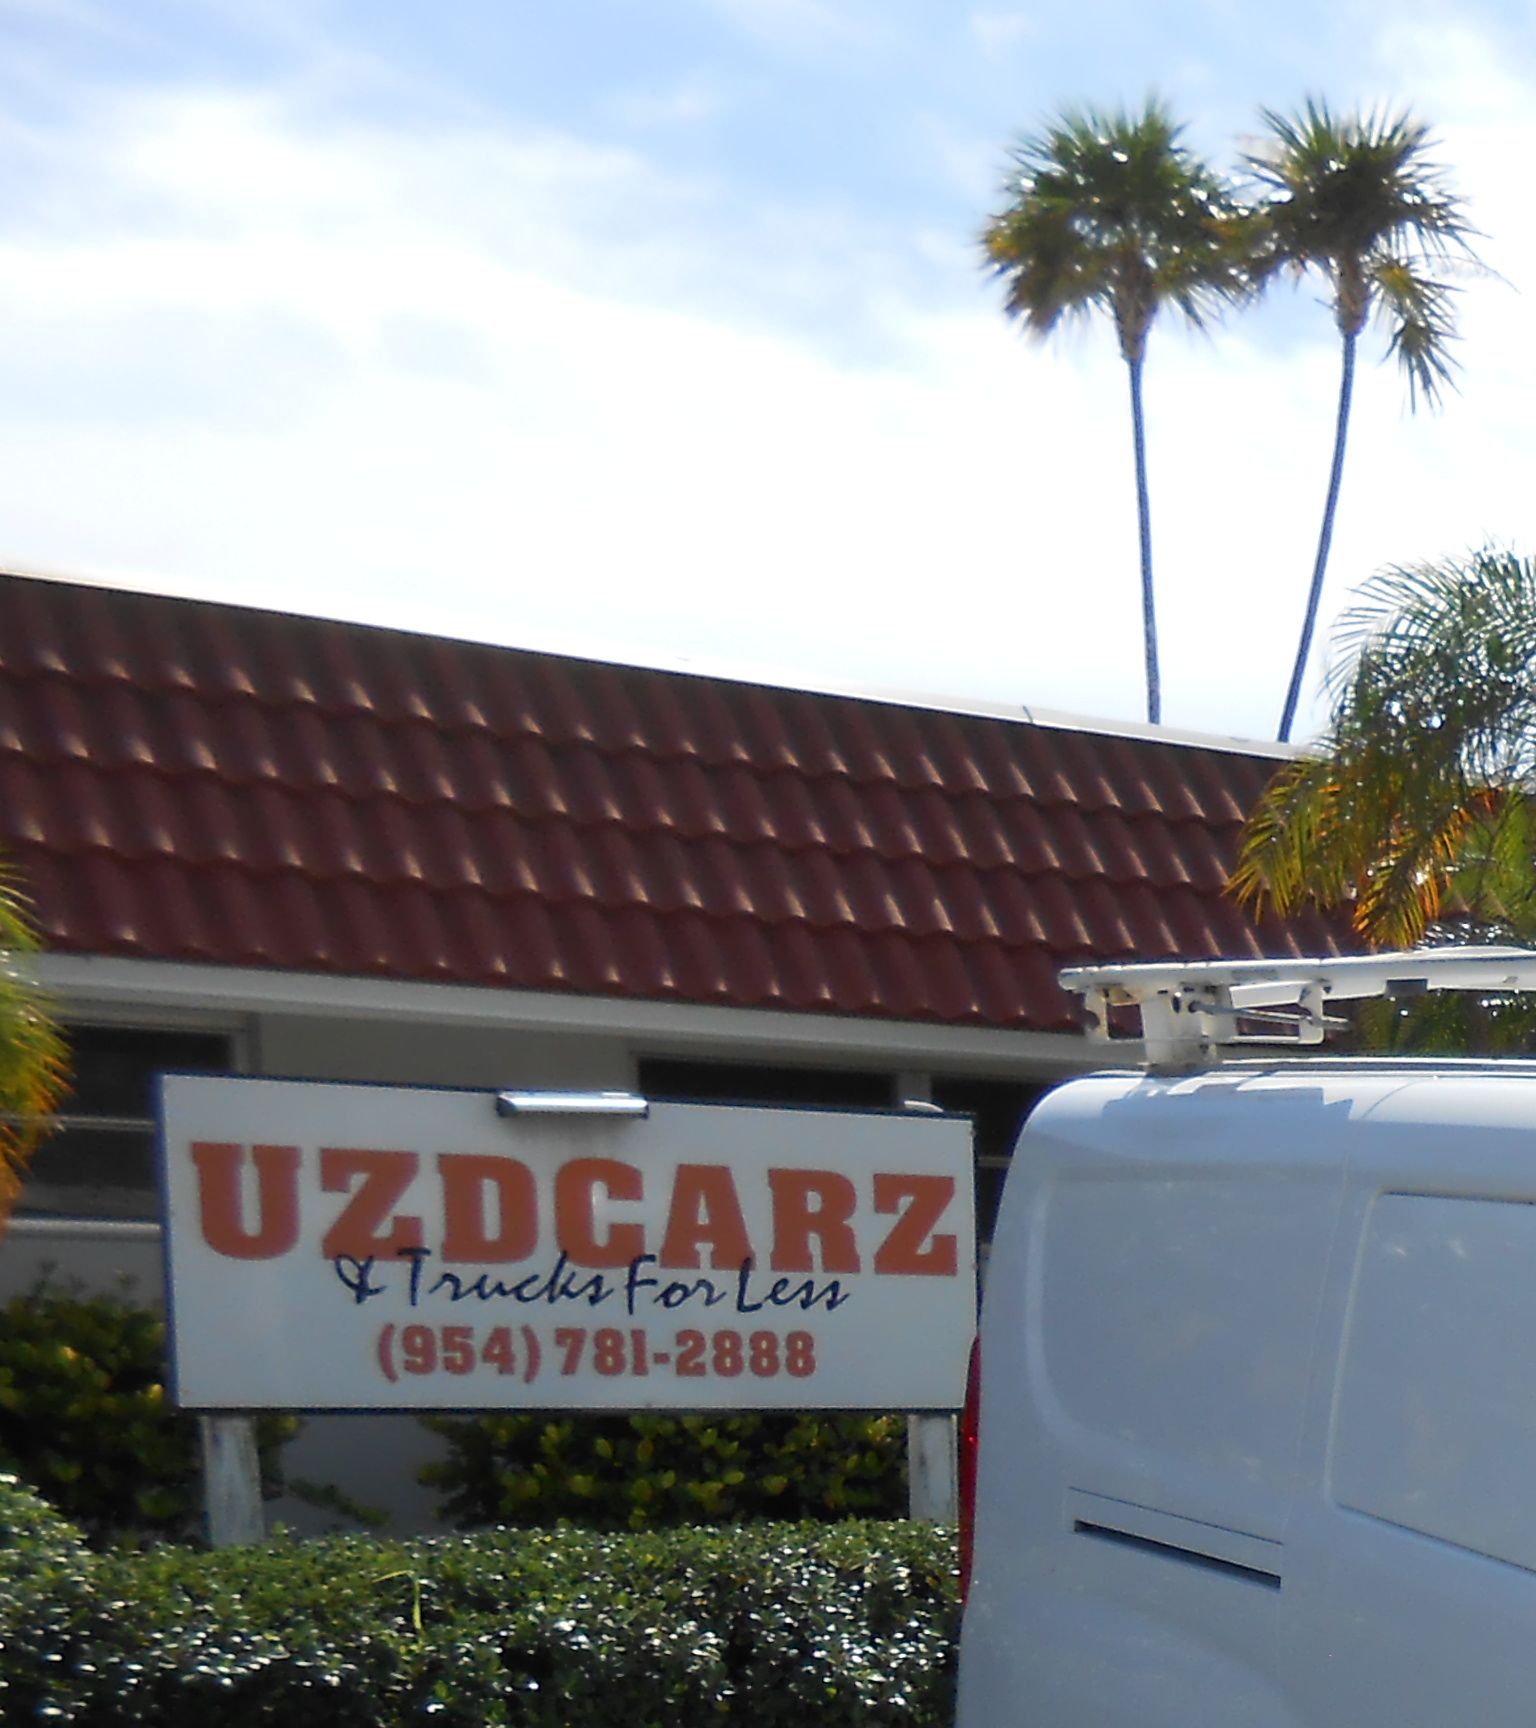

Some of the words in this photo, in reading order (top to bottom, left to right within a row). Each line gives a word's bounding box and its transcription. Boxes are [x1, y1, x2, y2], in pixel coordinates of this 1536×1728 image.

[191, 1142, 958, 1277] UZDCARZ
[334, 1252, 388, 1305] &
[397, 1246, 615, 1308] Trucks
[625, 1253, 727, 1316] For
[735, 1256, 851, 1313] Less
[376, 1322, 543, 1385] (954)
[554, 1326, 817, 1379] 781-2888
